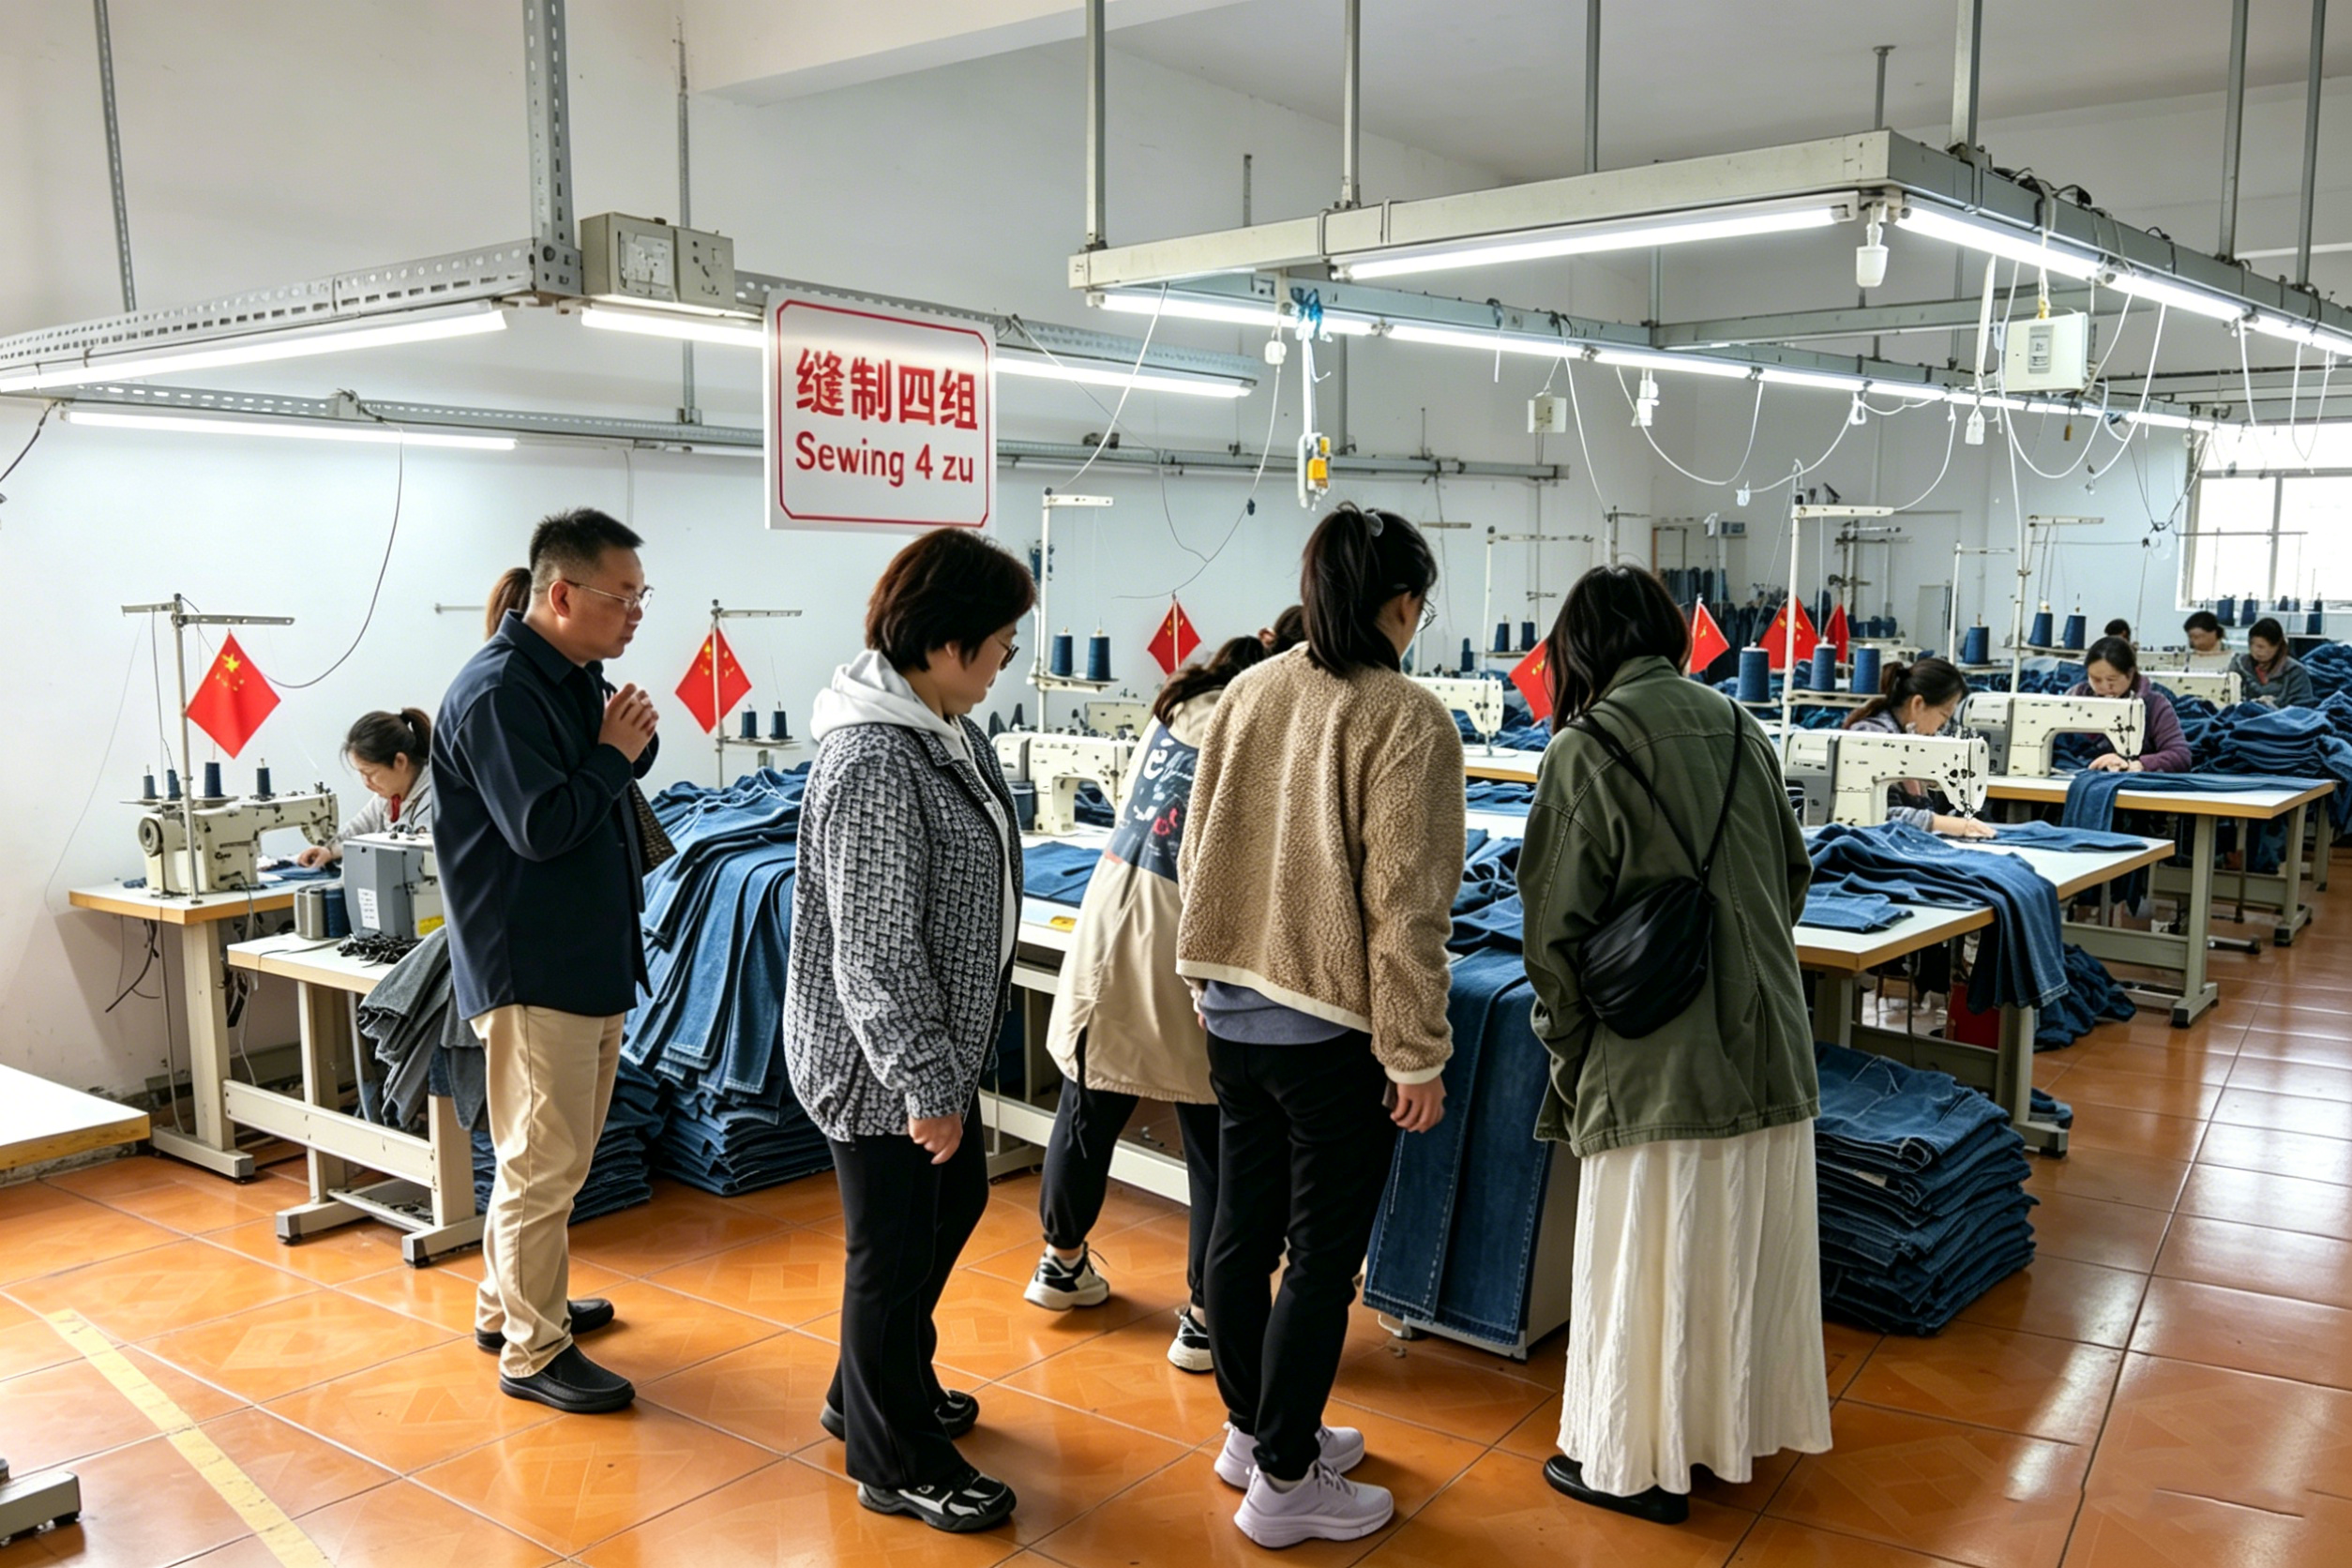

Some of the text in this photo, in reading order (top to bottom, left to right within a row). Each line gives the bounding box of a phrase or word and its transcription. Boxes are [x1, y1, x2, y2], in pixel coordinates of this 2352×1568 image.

[796, 348, 978, 430] 缝制四组
[796, 430, 973, 488] Sewing 4 zu
